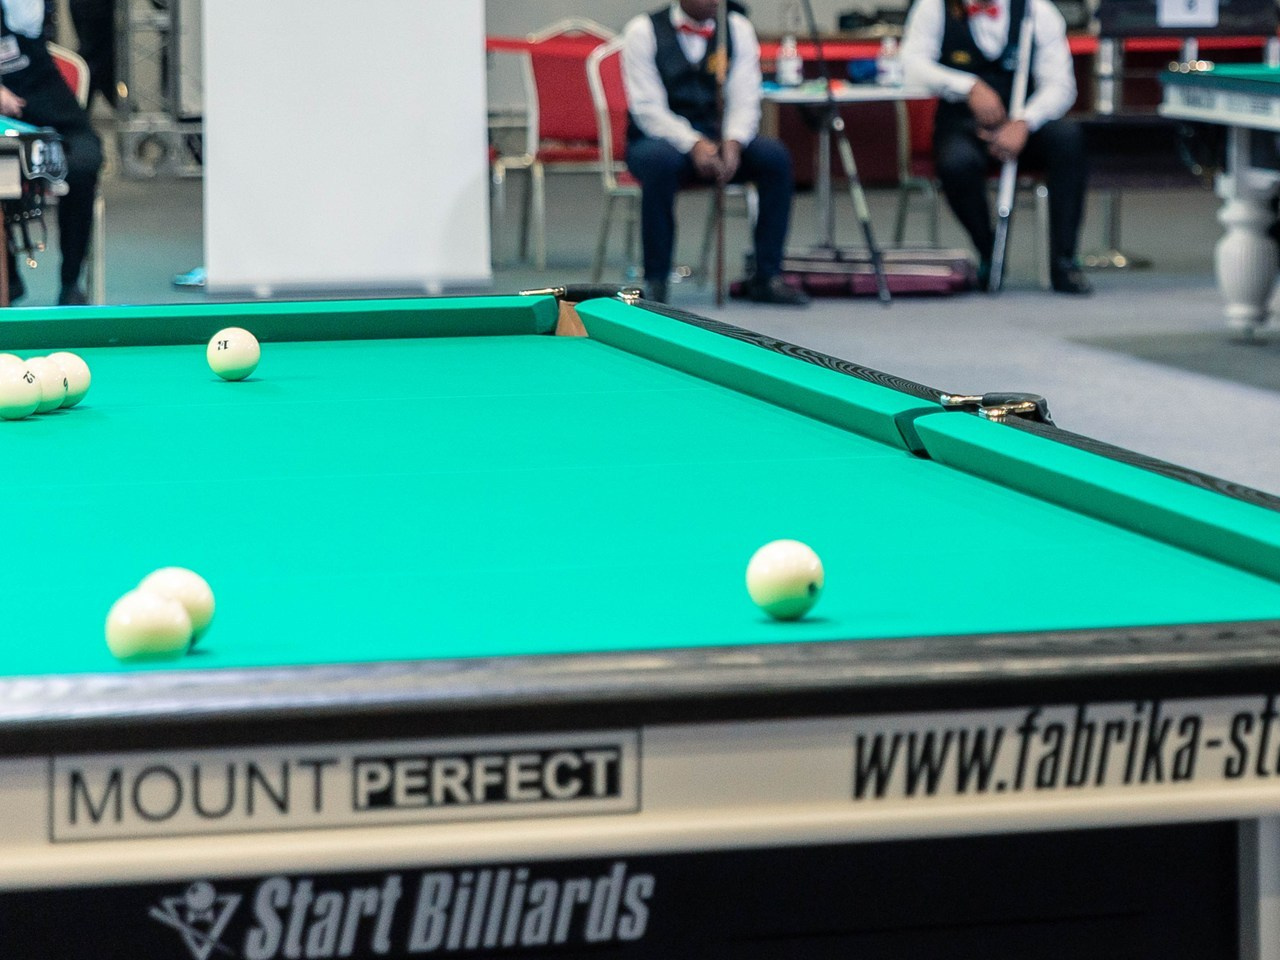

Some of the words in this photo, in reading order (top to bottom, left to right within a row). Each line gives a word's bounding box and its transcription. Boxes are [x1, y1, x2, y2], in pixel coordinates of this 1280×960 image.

[67, 757, 339, 826] MOUNT
[356, 749, 620, 810] PERFECT
[245, 875, 402, 959] Start
[408, 862, 655, 954] Billiards
